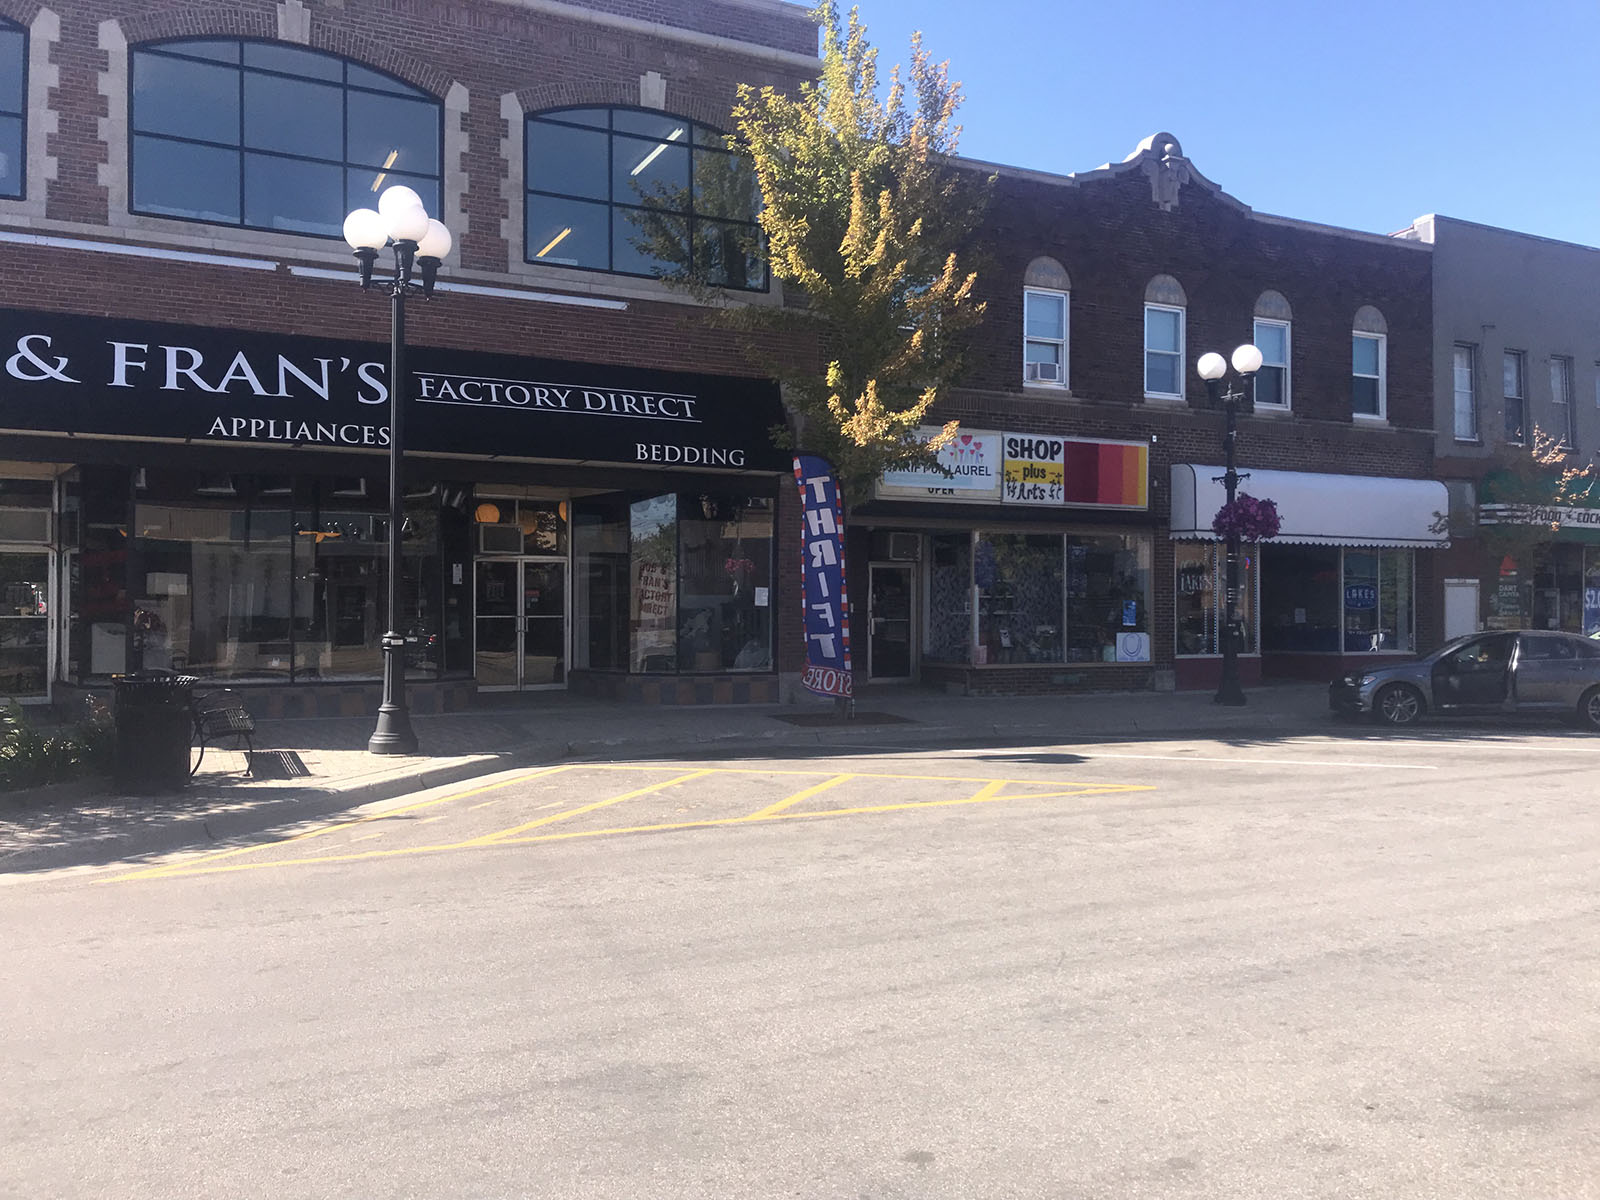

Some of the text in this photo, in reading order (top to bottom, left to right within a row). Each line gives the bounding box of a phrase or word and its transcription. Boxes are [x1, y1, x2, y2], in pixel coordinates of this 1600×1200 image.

[5, 334, 389, 405] & FRAN'S
[419, 377, 696, 418] FACTORY DIRECT
[207, 416, 391, 446] APPLIANCES
[635, 443, 745, 466] BEDDING
[1007, 437, 1062, 461] SHOP
[888, 461, 928, 473] RIFT
[949, 464, 992, 477] LAUREL
[1023, 463, 1047, 481] plus
[1346, 589, 1375, 599] LAKES
